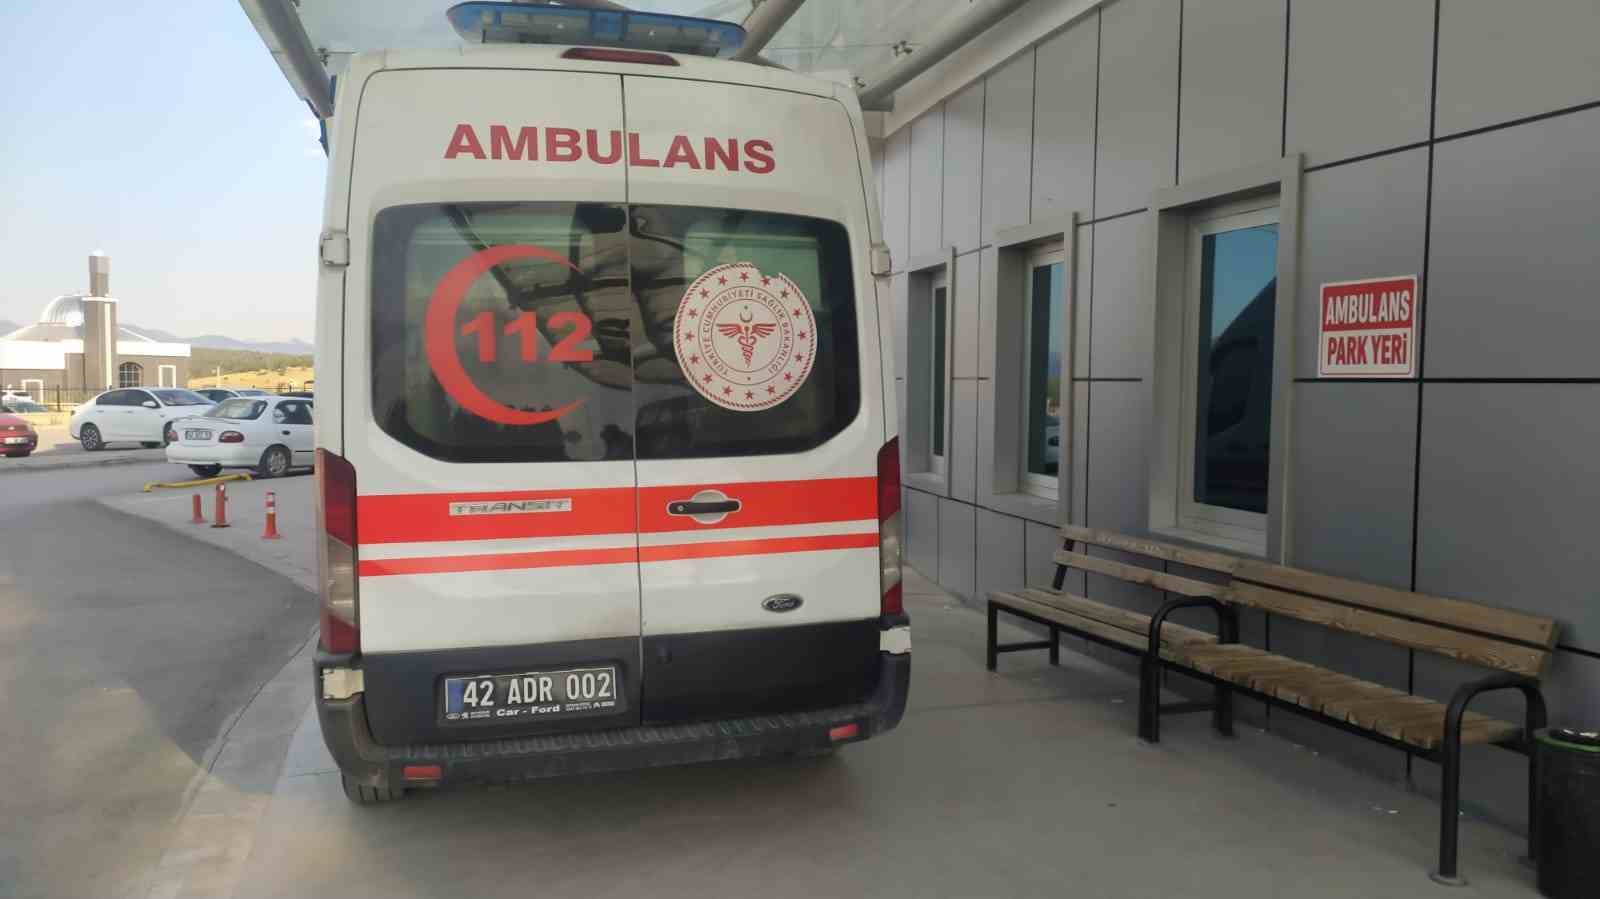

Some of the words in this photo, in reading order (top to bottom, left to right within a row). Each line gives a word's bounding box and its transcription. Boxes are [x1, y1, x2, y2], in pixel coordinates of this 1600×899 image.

[444, 123, 776, 174] AMBULANS
[1326, 290, 1410, 325] AMBULANS
[461, 311, 593, 363] 112
[1327, 336, 1367, 366] PARK
[1371, 332, 1408, 365] YERİ
[450, 499, 571, 515] TRANSIT
[463, 680, 495, 707] 42
[507, 676, 553, 704] ADR
[566, 672, 611, 700] 002
[496, 708, 521, 717] Car
[531, 704, 561, 714] Ford
